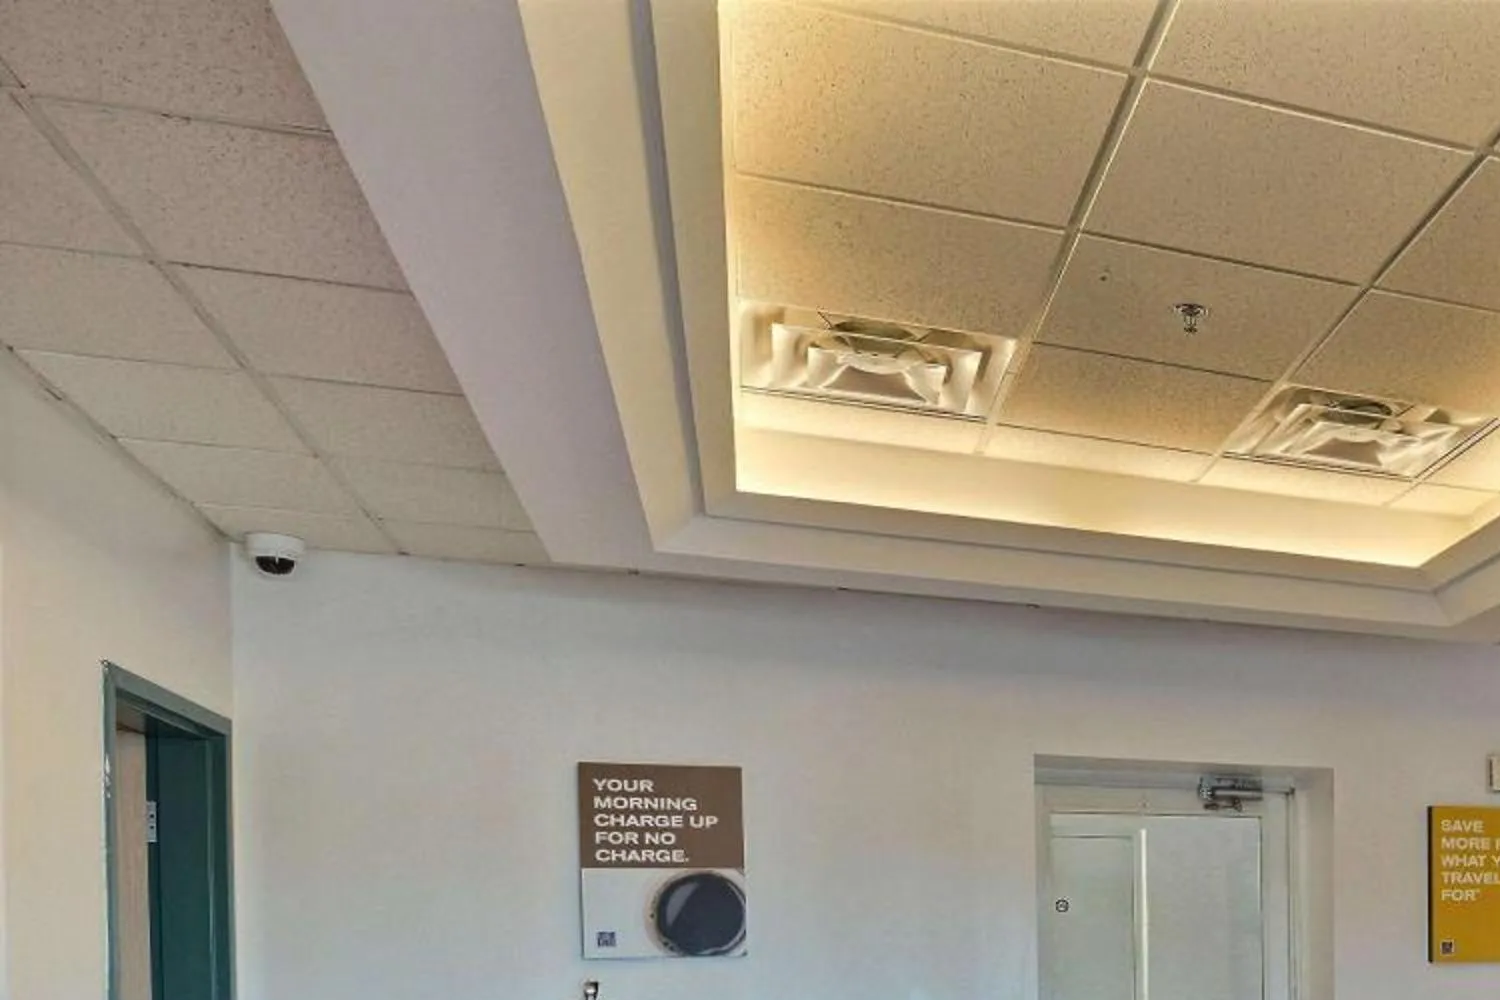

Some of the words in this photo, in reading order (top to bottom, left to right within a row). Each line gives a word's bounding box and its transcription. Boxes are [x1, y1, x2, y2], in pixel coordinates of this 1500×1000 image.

[593, 778, 654, 792] YOUR
[593, 796, 698, 811] MORNING
[593, 813, 683, 828] CHARGE
[689, 815, 719, 829] UP
[1441, 819, 1485, 833] SAVE
[595, 831, 639, 845] FOR
[644, 832, 676, 846] NO
[1441, 837, 1491, 851] MORE
[595, 849, 690, 863] CHARGE.
[1441, 855, 1487, 868] WHAT
